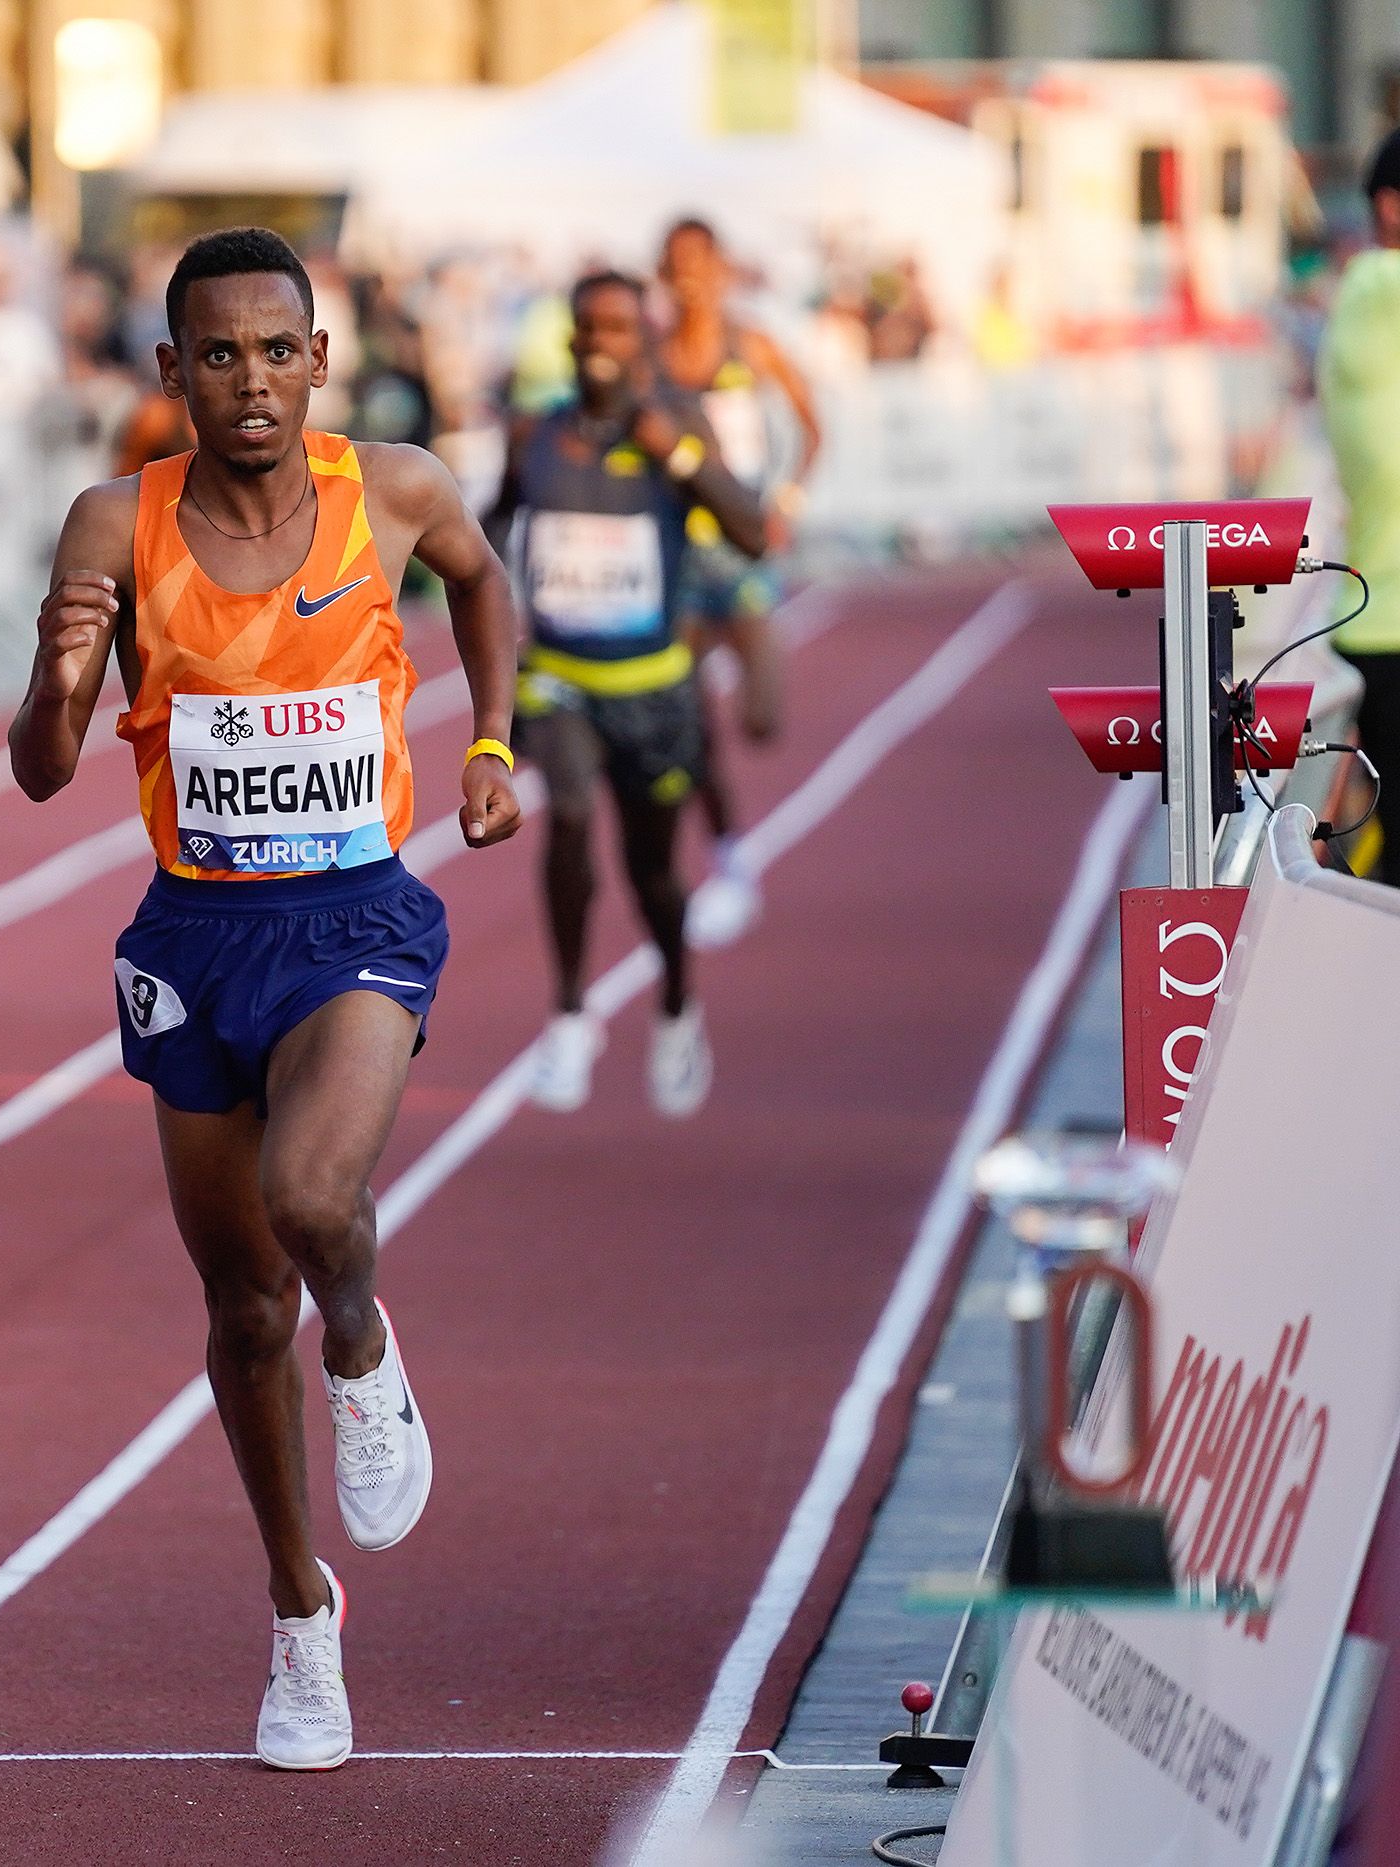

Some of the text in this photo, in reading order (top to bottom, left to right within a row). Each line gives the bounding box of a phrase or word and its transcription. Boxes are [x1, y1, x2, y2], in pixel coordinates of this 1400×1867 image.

[1149, 522, 1272, 549] OEGA
[260, 697, 346, 737] UBS
[185, 753, 375, 816] AREGAWI
[231, 839, 338, 865] ZURICH
[132, 974, 158, 1029] 9
[1134, 1314, 1329, 1642] medica
